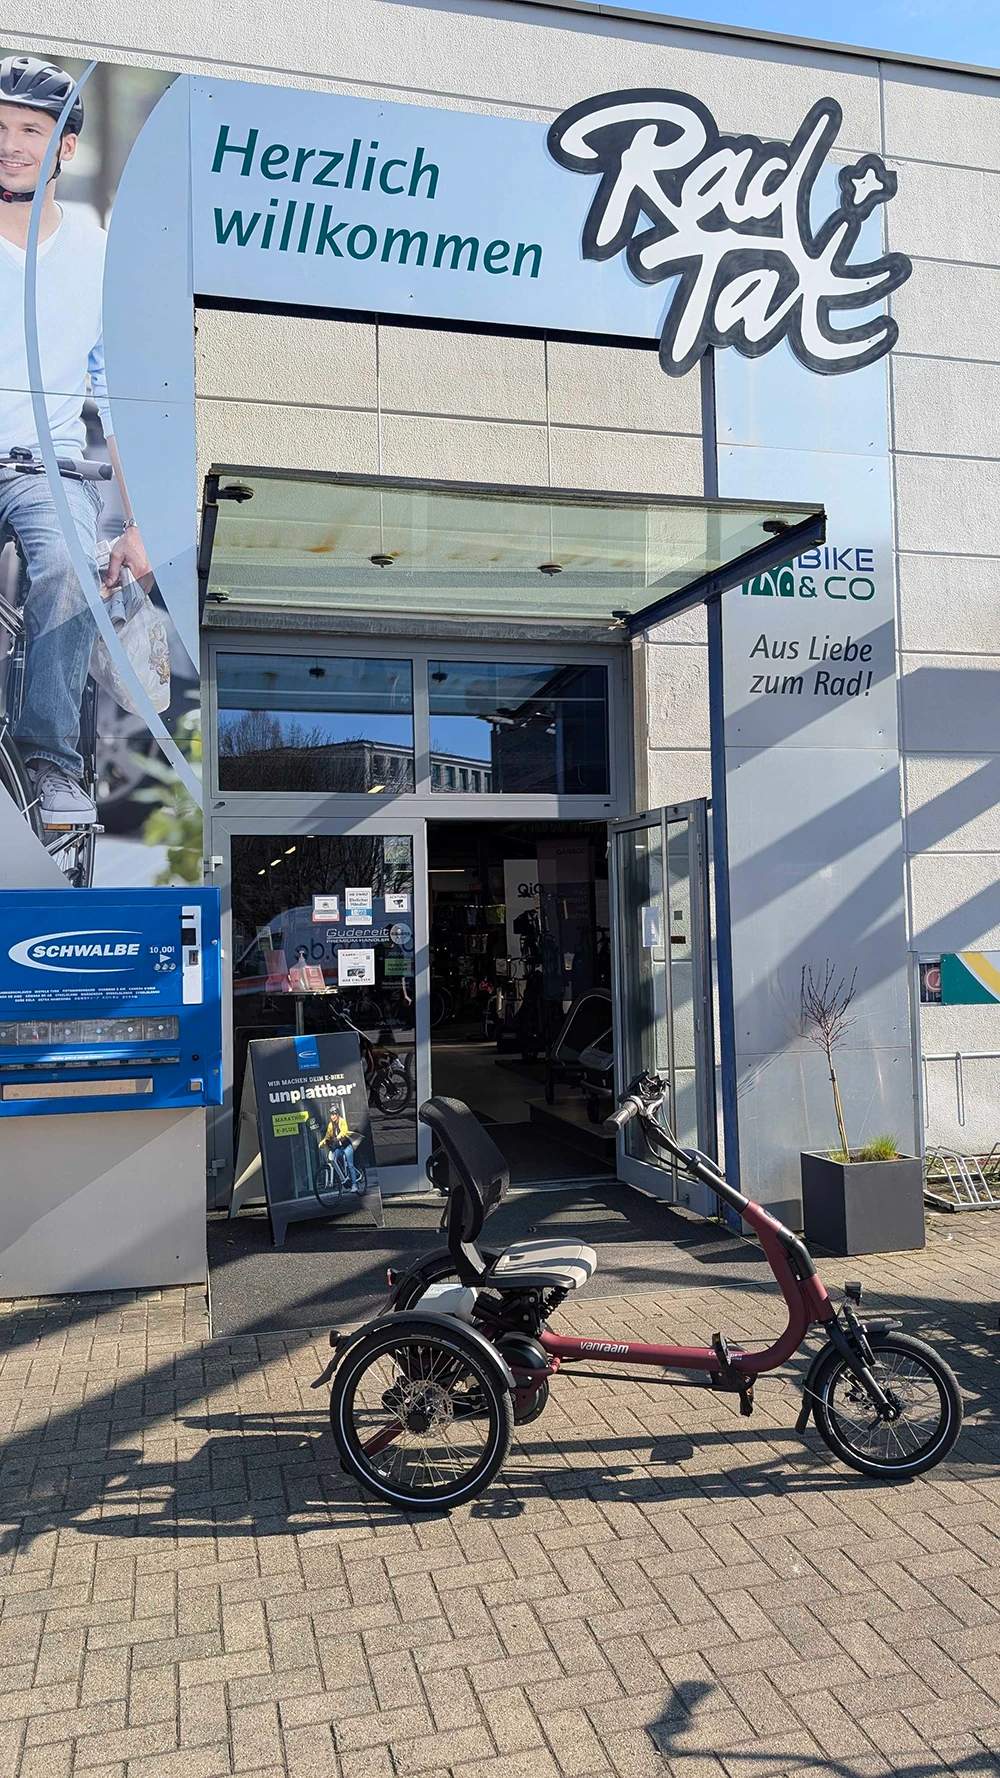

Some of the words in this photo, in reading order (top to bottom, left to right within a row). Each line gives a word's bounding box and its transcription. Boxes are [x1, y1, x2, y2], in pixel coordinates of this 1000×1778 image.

[210, 124, 441, 200] Herzlich
[555, 99, 830, 250] Rad
[212, 197, 545, 279] willkommen
[641, 224, 892, 364] Tat
[798, 547, 875, 572] BIKE
[799, 575, 818, 598] &
[824, 576, 875, 601] CO
[749, 633, 800, 660] Aus
[808, 635, 873, 663] Liebe
[750, 674, 804, 695] zum
[813, 670, 874, 697] Rad!
[326, 927, 390, 937] Gudereit
[32, 943, 141, 958] SCHWALBE
[281, 1077, 308, 1086] MACHEN
[325, 1073, 345, 1081] E-BIKE
[274, 1113, 306, 1122] MARATHON
[580, 1340, 629, 1354] vanraam
